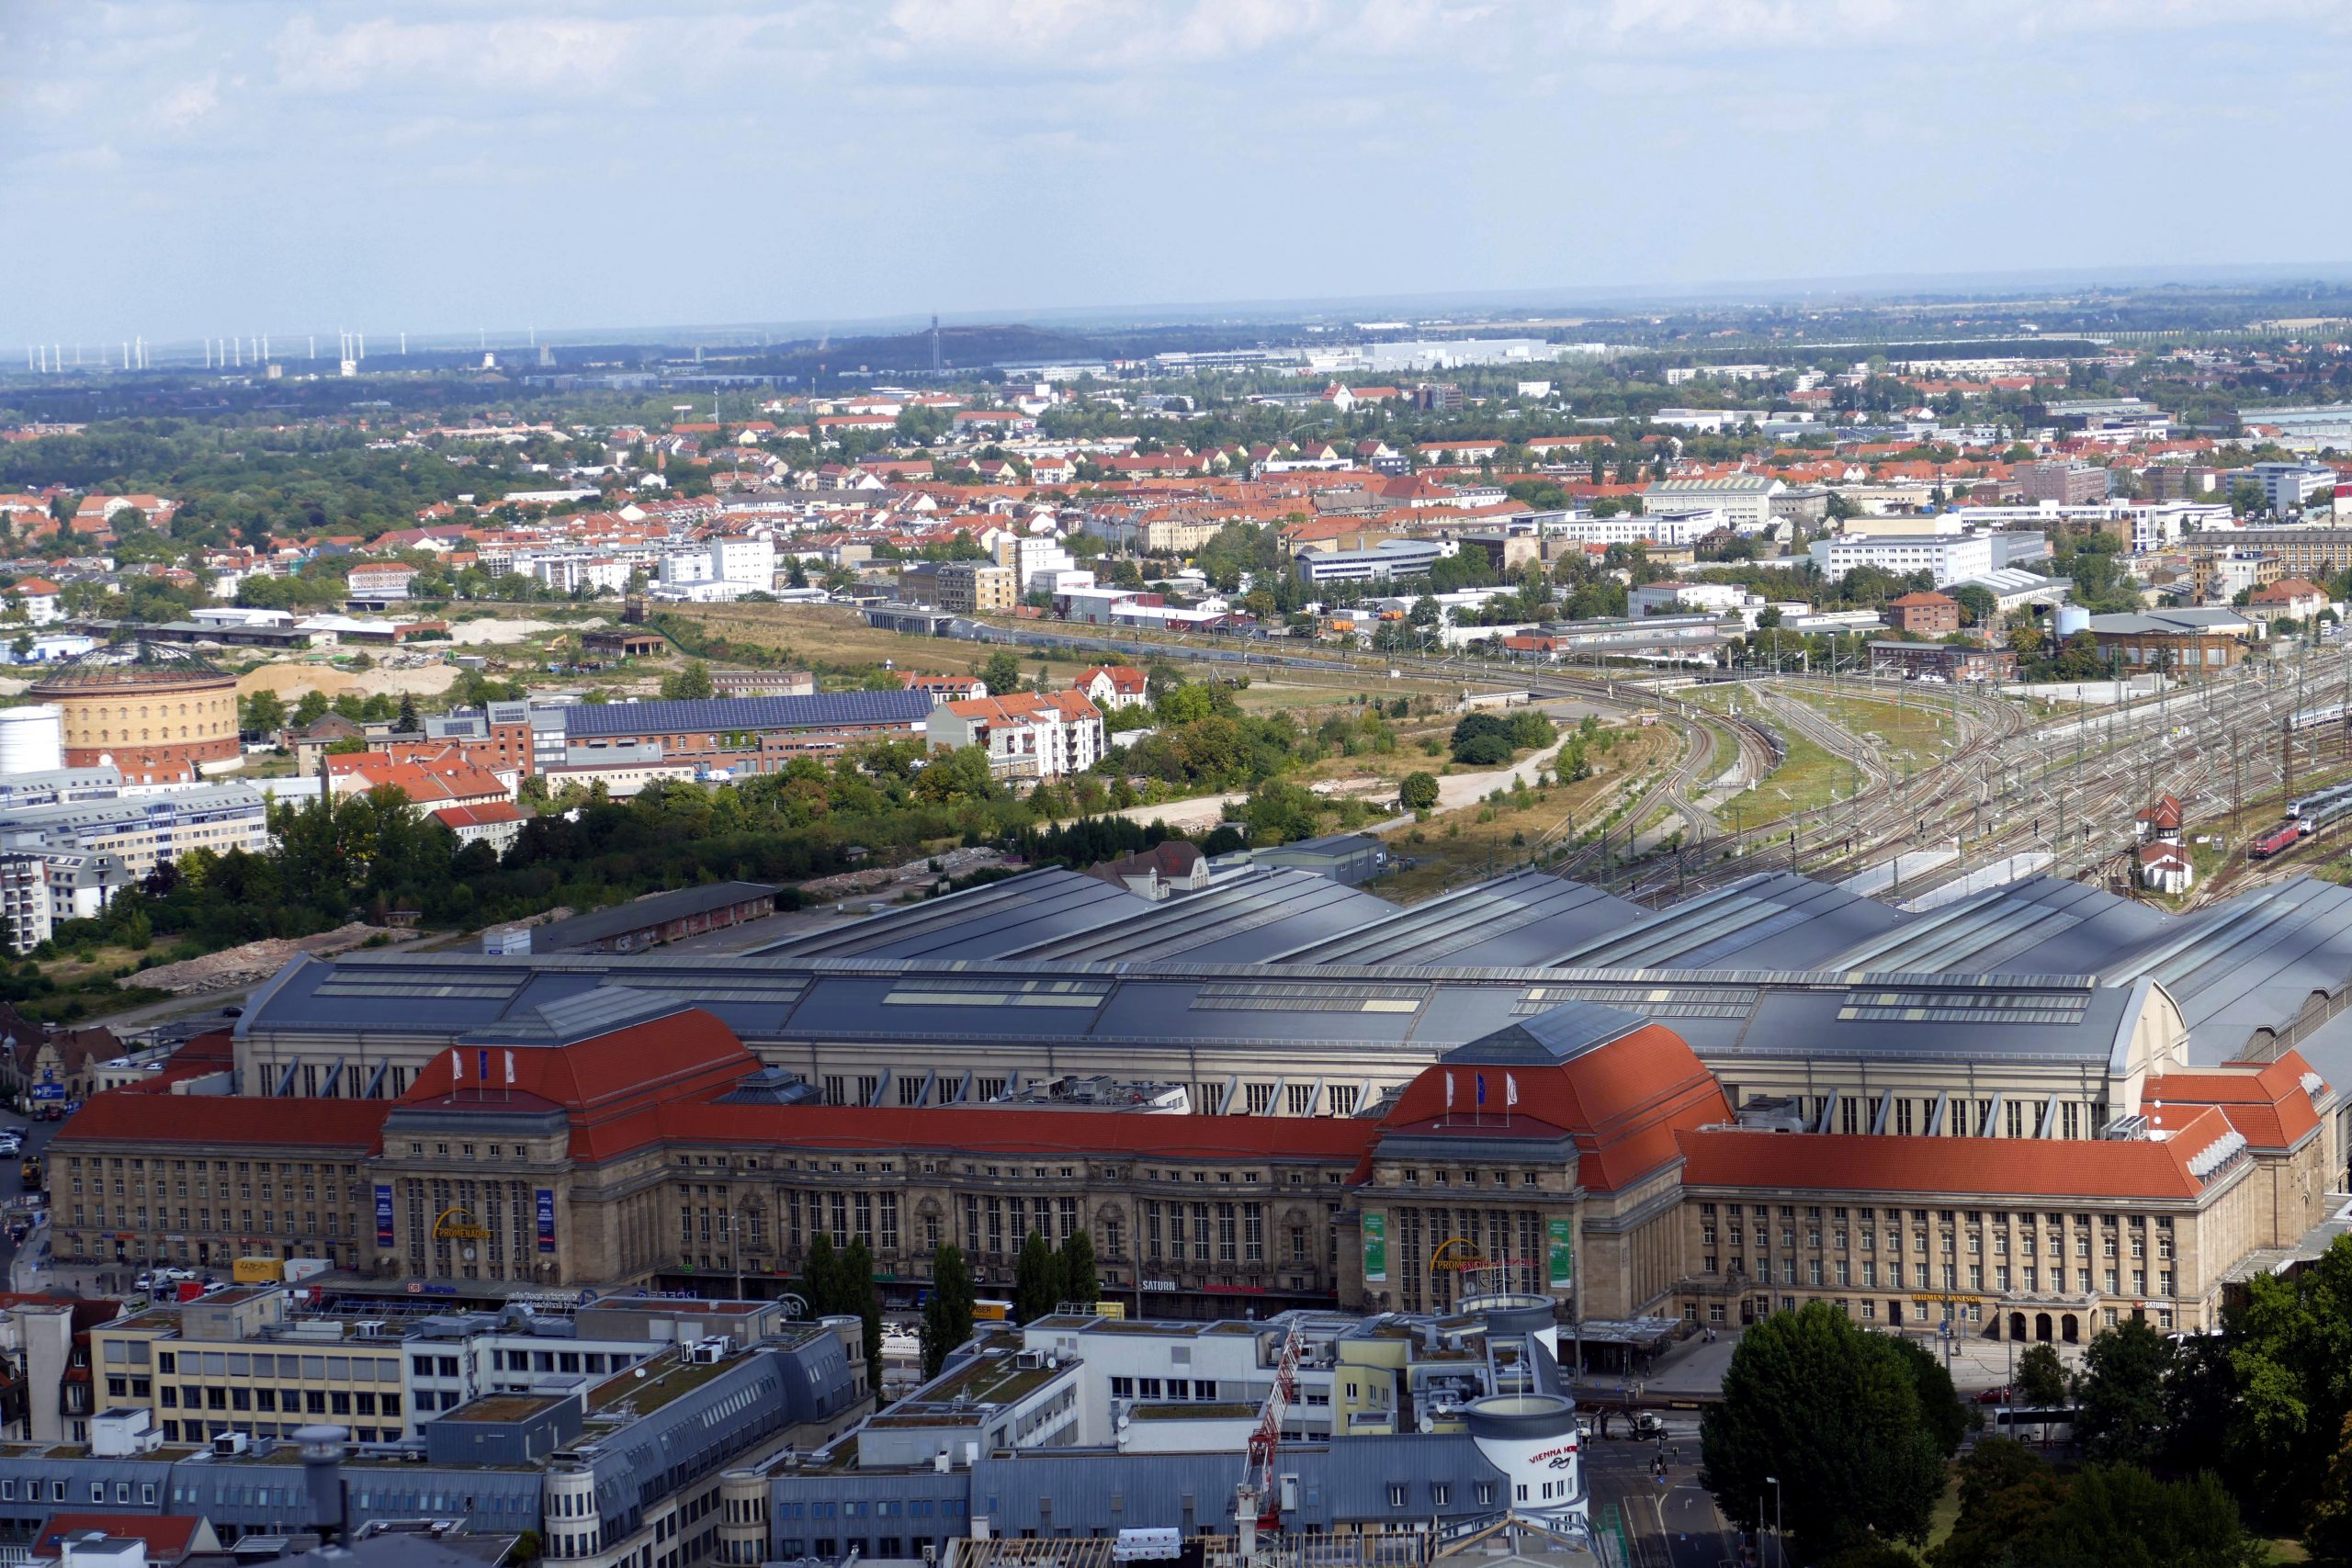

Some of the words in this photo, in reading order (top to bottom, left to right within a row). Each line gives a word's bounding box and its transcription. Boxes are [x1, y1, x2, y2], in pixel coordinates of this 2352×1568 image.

[439, 1228, 492, 1239] PROMENADEN
[1142, 1280, 1176, 1291] SATURN
[2144, 1301, 2169, 1309] SATURN
[1529, 1449, 1562, 1463] VIENNA
